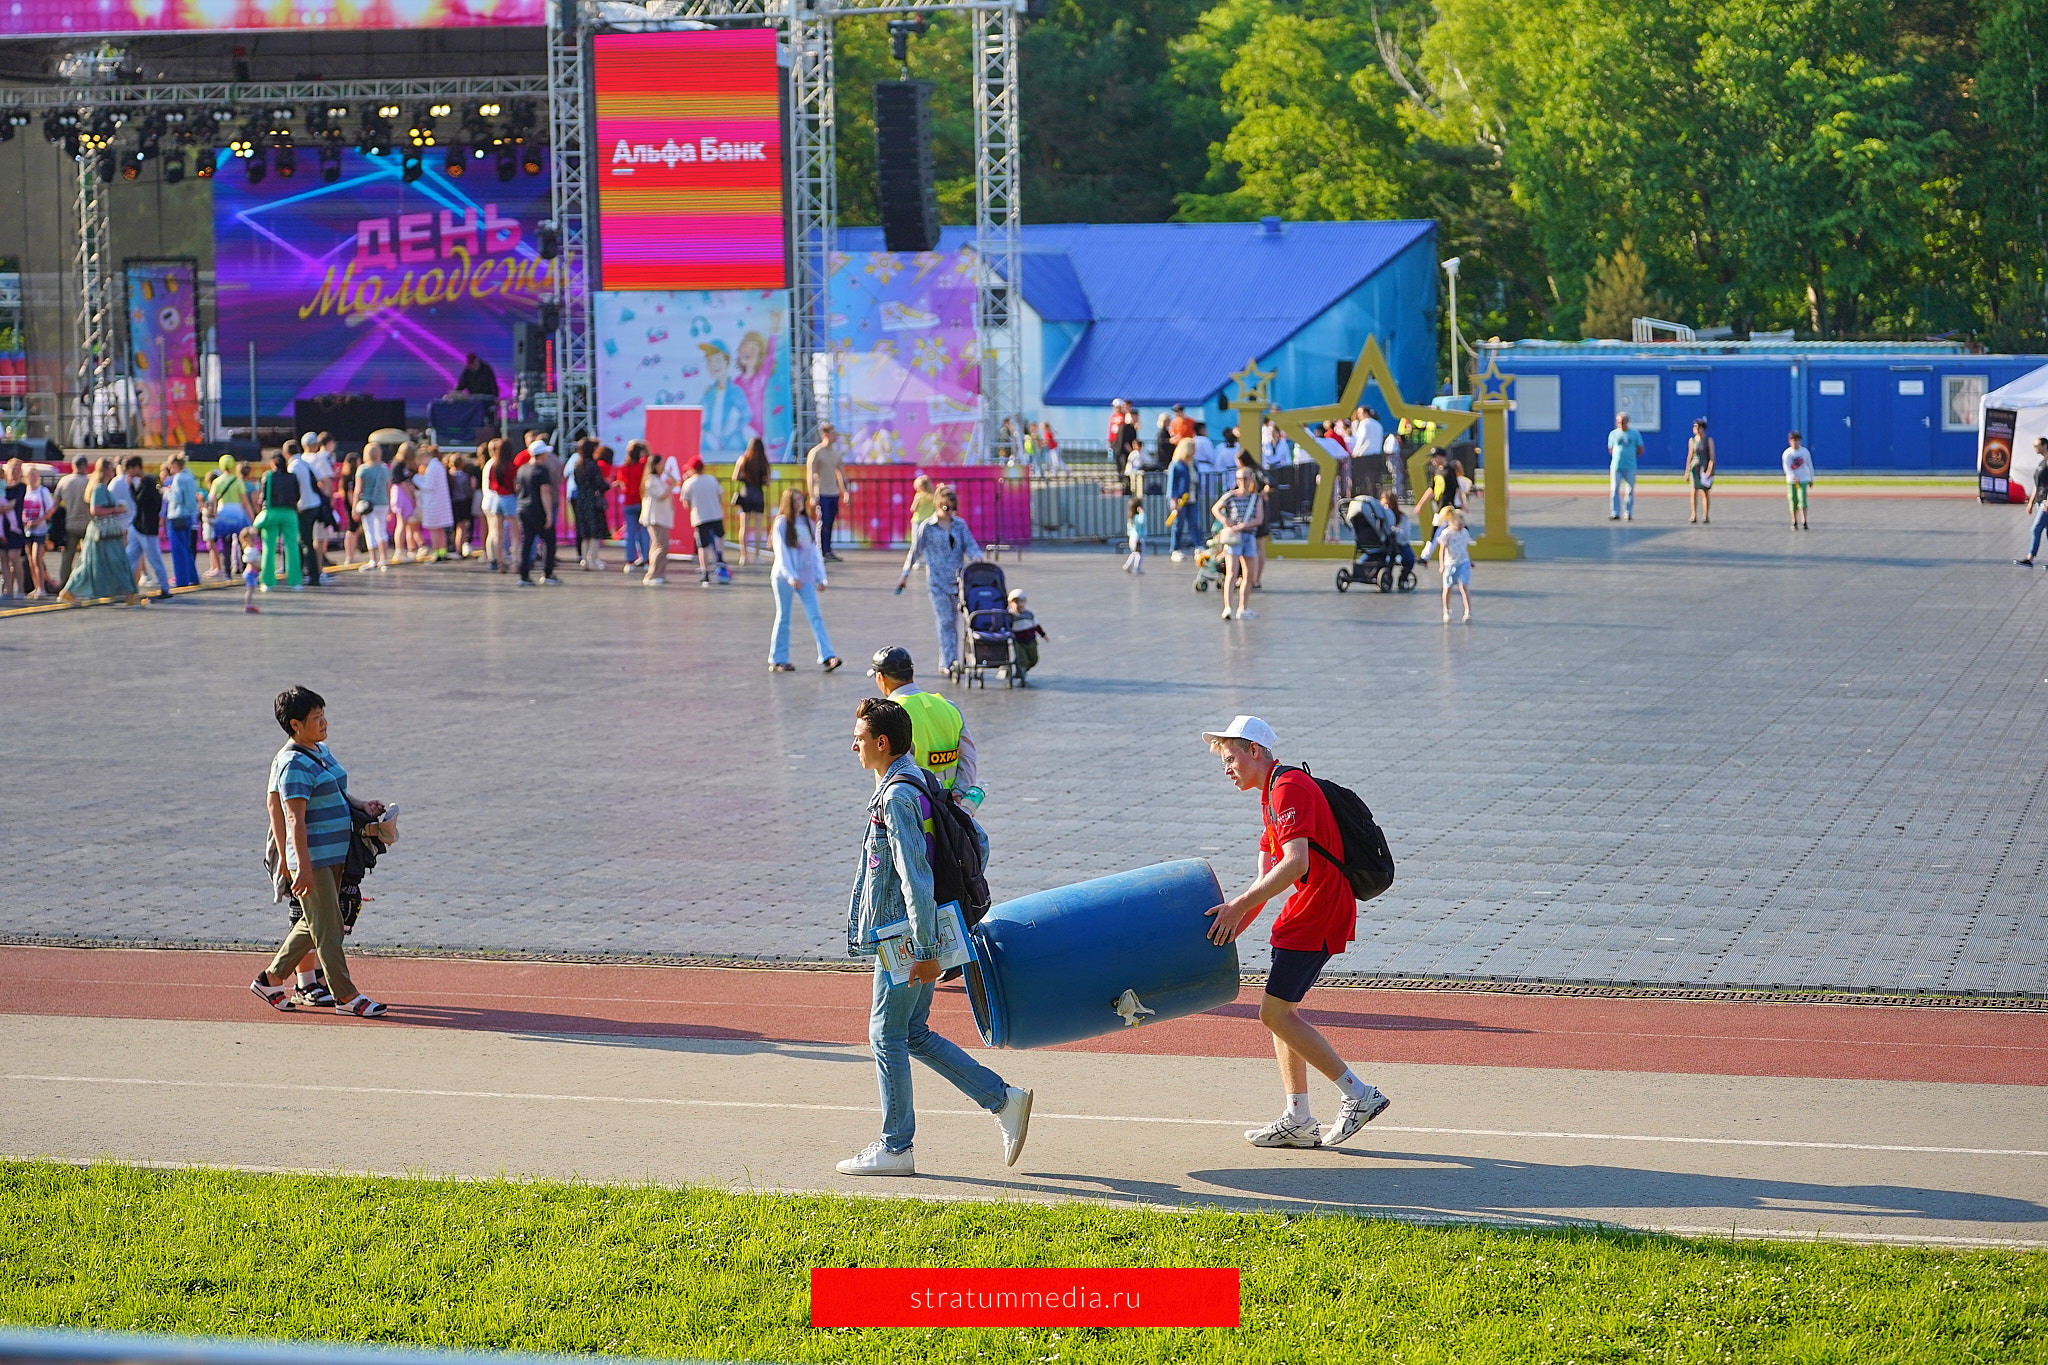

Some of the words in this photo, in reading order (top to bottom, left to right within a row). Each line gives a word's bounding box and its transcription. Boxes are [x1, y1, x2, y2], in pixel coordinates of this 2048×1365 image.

[612, 138, 697, 169] Альфа
[700, 137, 767, 162] Банк
[351, 203, 522, 275] ДЕНЬ
[931, 750, 959, 763] ОХРА
